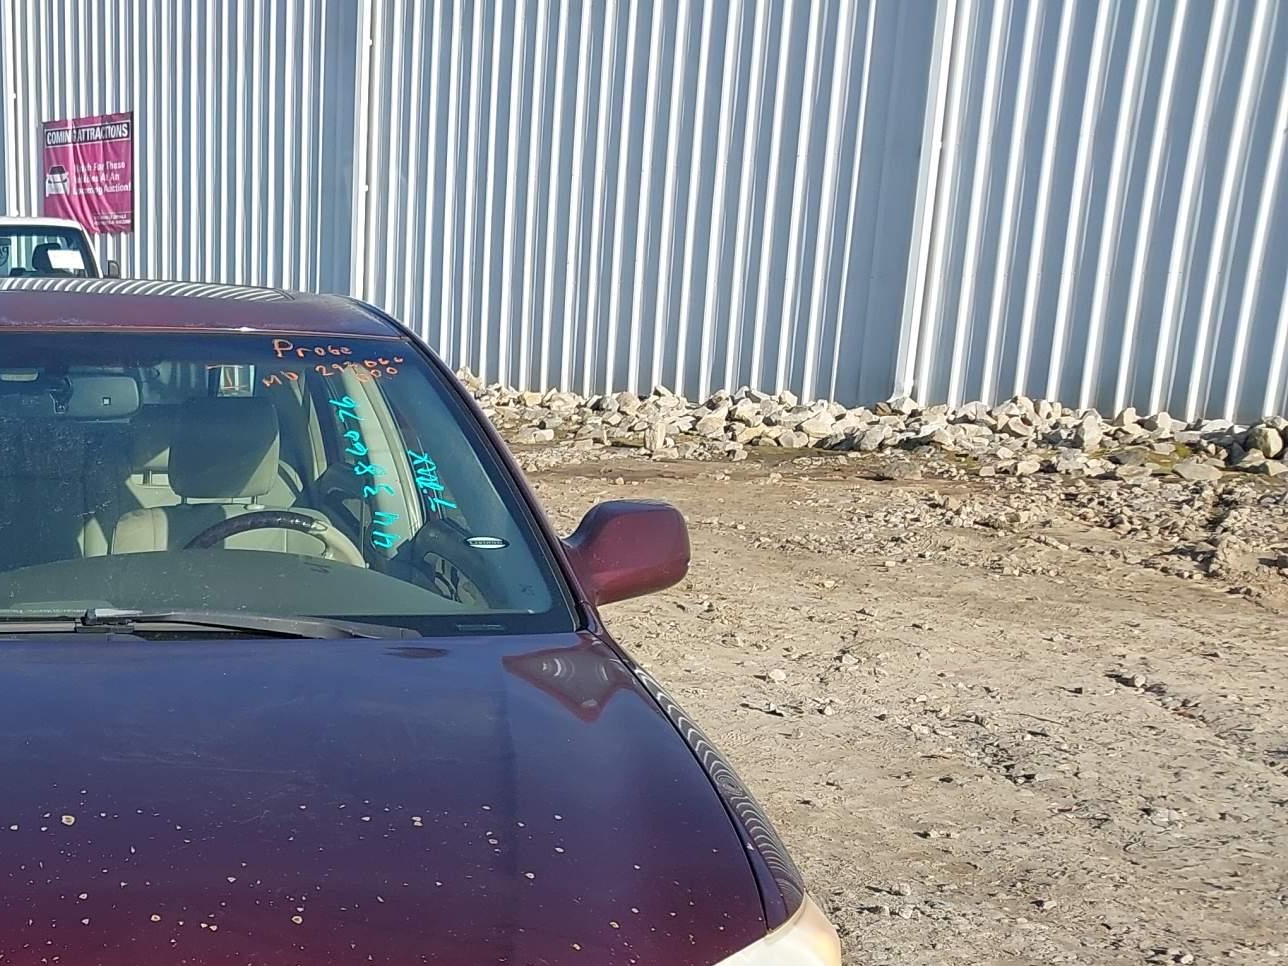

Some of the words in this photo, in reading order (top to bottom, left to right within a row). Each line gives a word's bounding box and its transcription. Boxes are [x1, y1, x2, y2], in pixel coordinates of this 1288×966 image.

[77, 123, 129, 142] ATTRACTIONS
[106, 160, 126, 170] These
[272, 338, 354, 359] Probe
